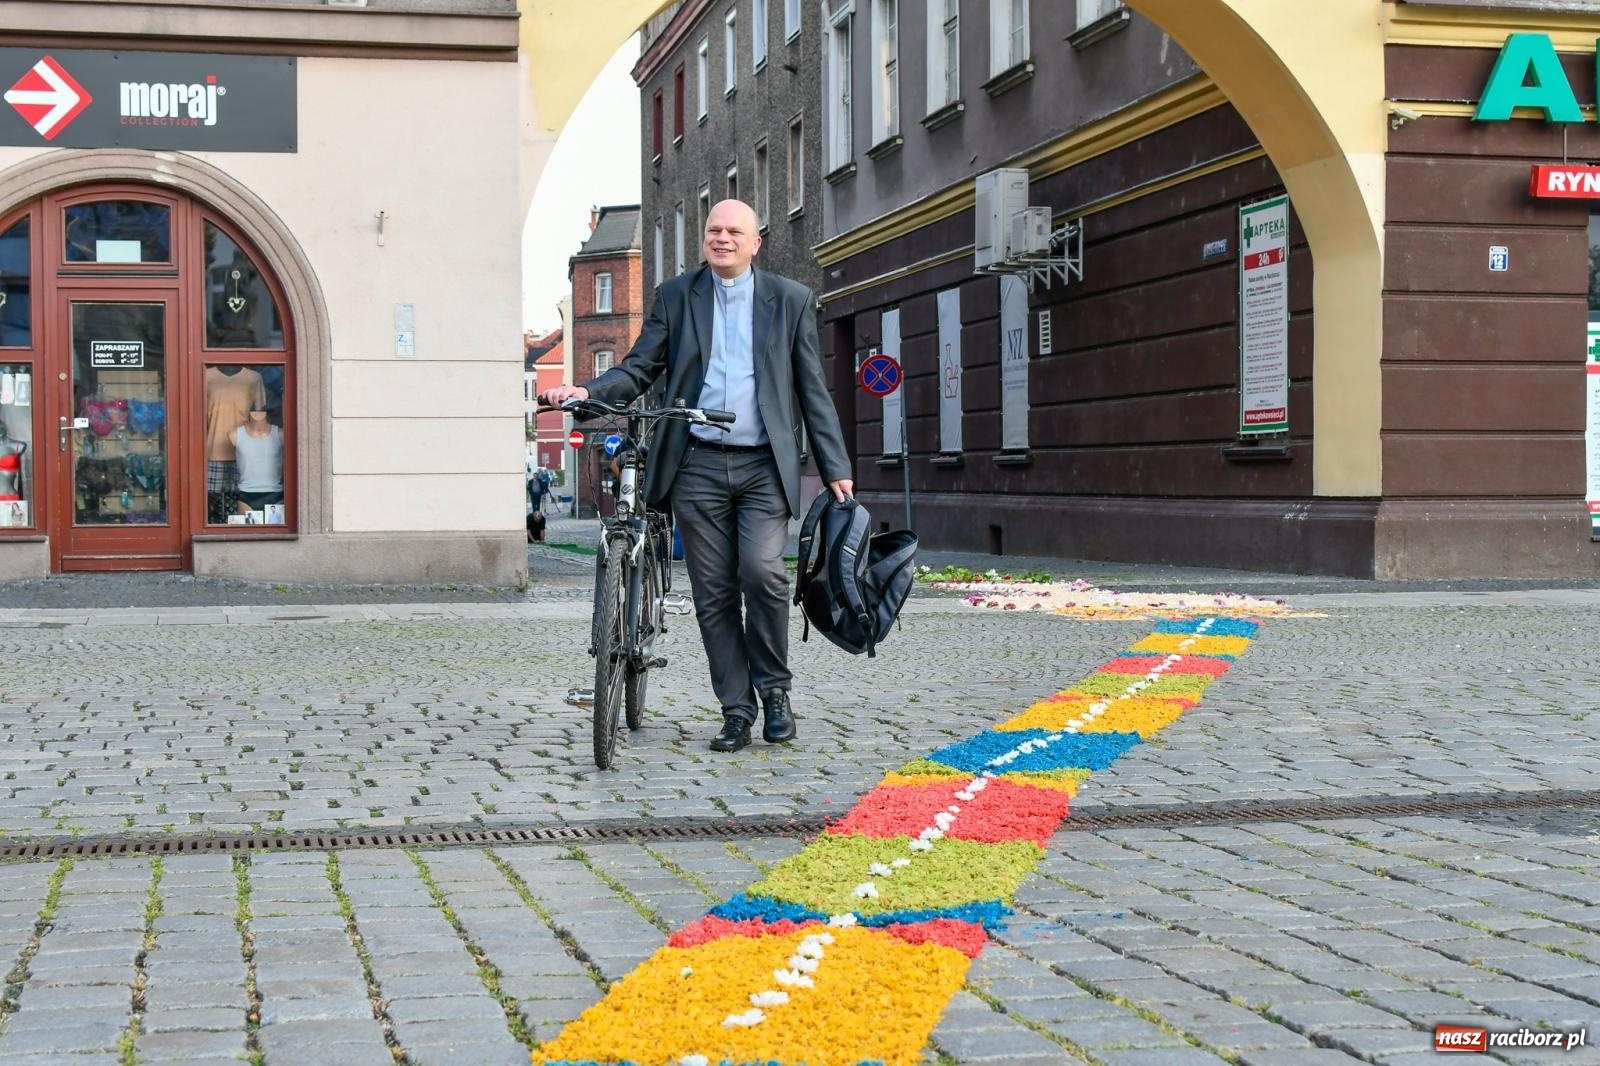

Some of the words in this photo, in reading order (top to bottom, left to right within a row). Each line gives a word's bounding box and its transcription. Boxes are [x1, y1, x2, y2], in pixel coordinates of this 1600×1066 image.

[1472, 32, 1600, 125] A
[120, 117, 199, 126] COLLECTION
[1254, 218, 1286, 238] APTEKA
[1258, 252, 1270, 267] 24h
[1492, 254, 1504, 266] 12
